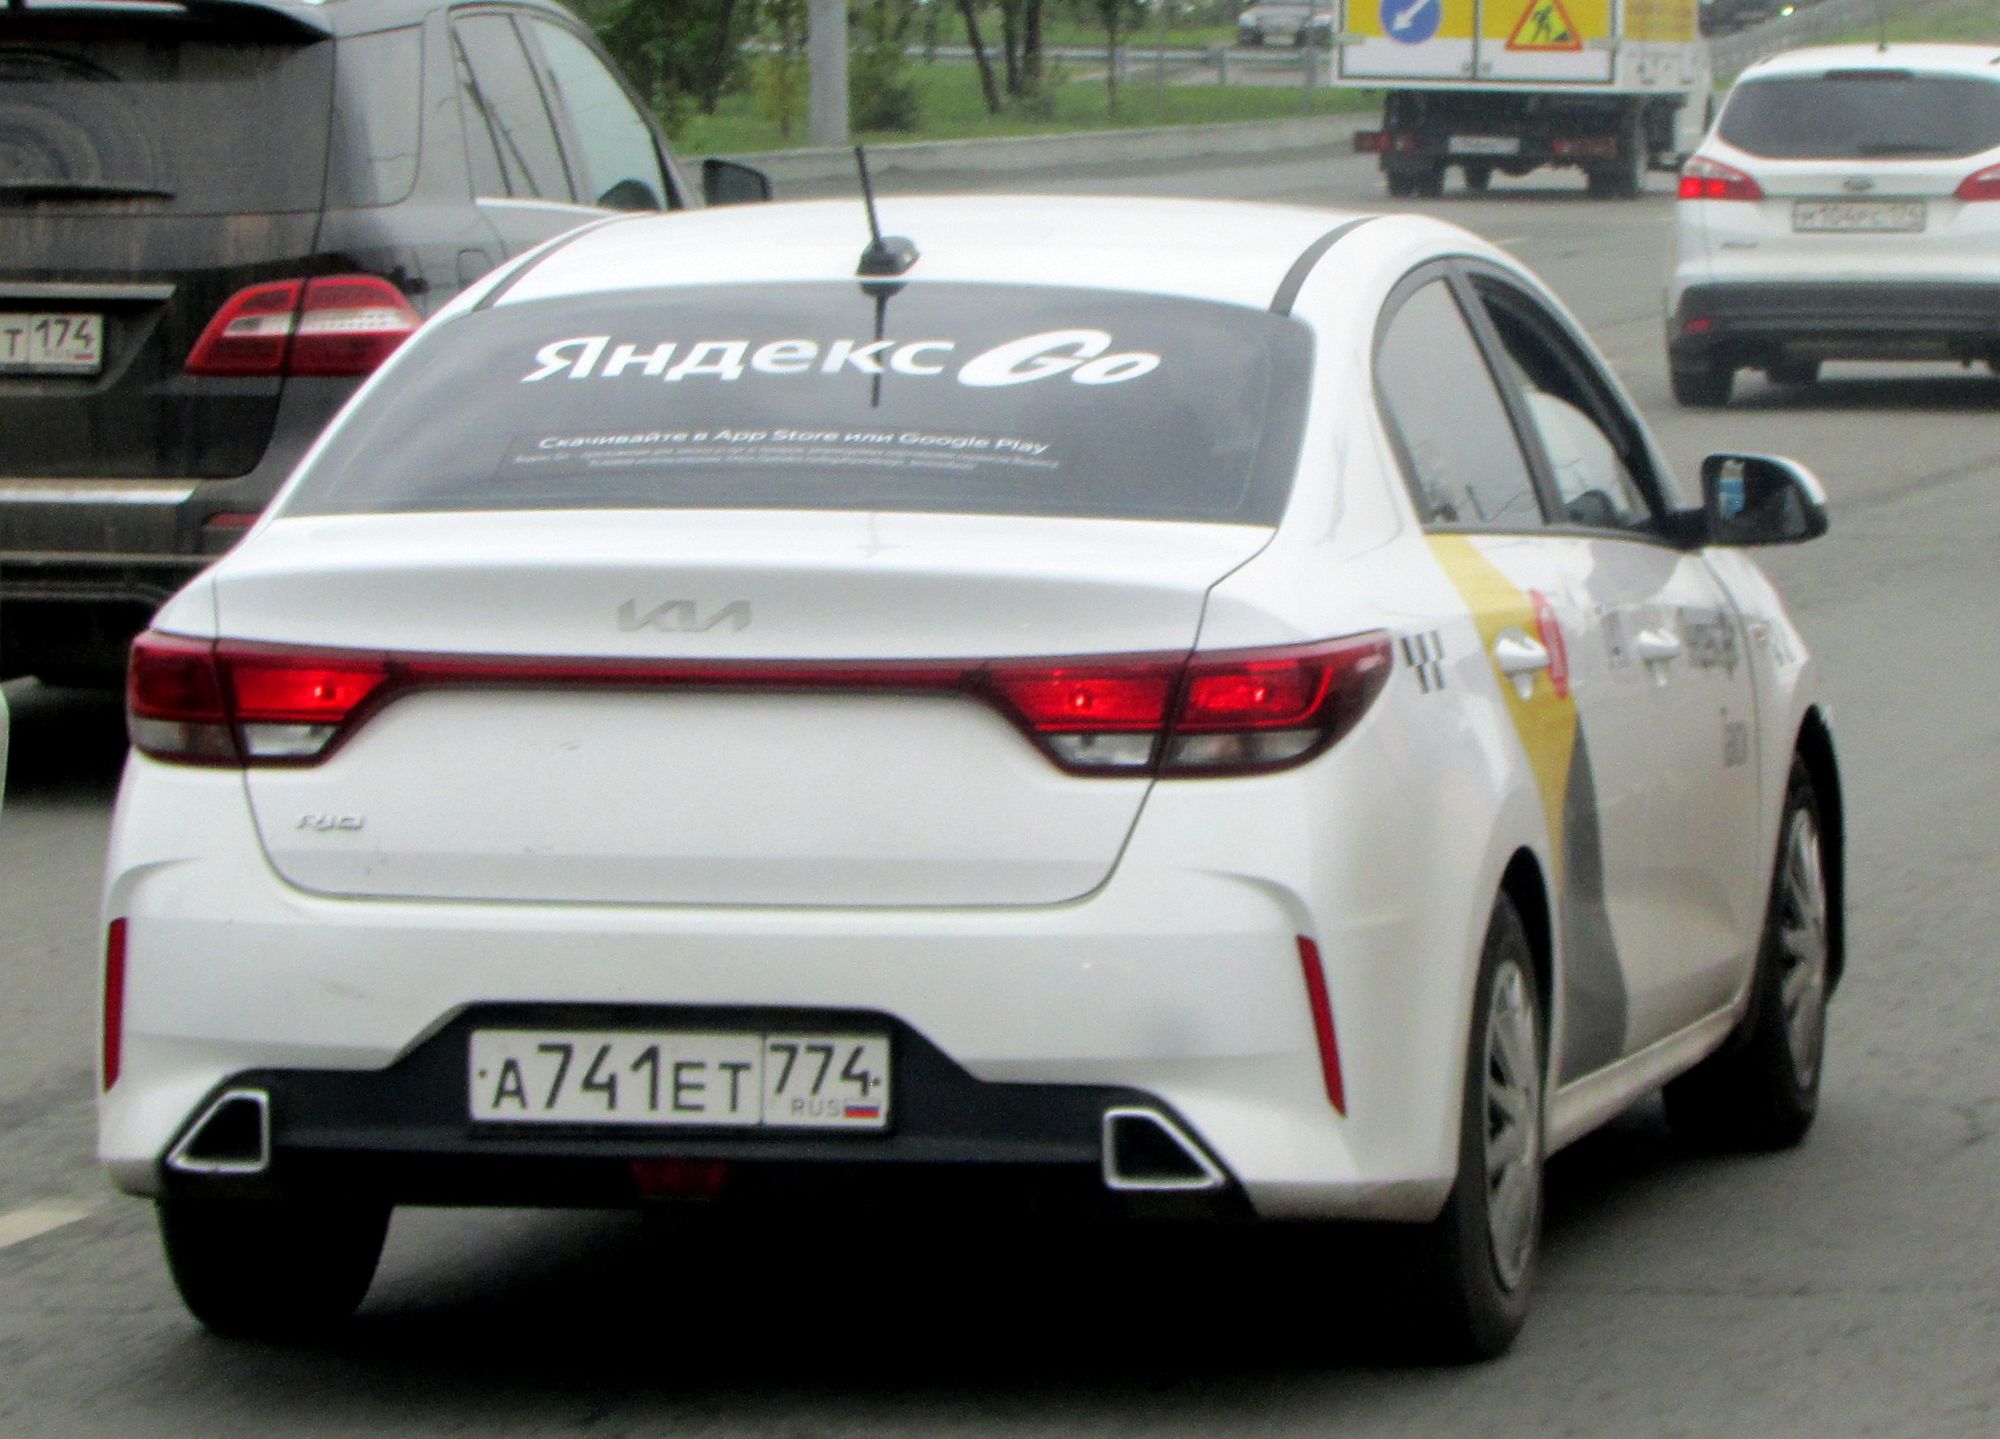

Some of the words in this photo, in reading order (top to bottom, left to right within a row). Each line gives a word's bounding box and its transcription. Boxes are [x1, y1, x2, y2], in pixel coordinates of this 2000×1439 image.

[35, 318, 95, 349] 174
[521, 335, 956, 383] Яндекс
[957, 329, 1161, 387] Go
[538, 432, 688, 450] Скачивайте
[692, 432, 707, 443] в
[713, 430, 767, 443] App
[770, 430, 839, 443] Store
[844, 433, 894, 444] или
[899, 432, 990, 449] Google
[994, 437, 1049, 455] Play
[491, 1043, 752, 1112] А741ЕТ
[769, 1044, 870, 1097] 774
[791, 1098, 841, 1117] RUS
